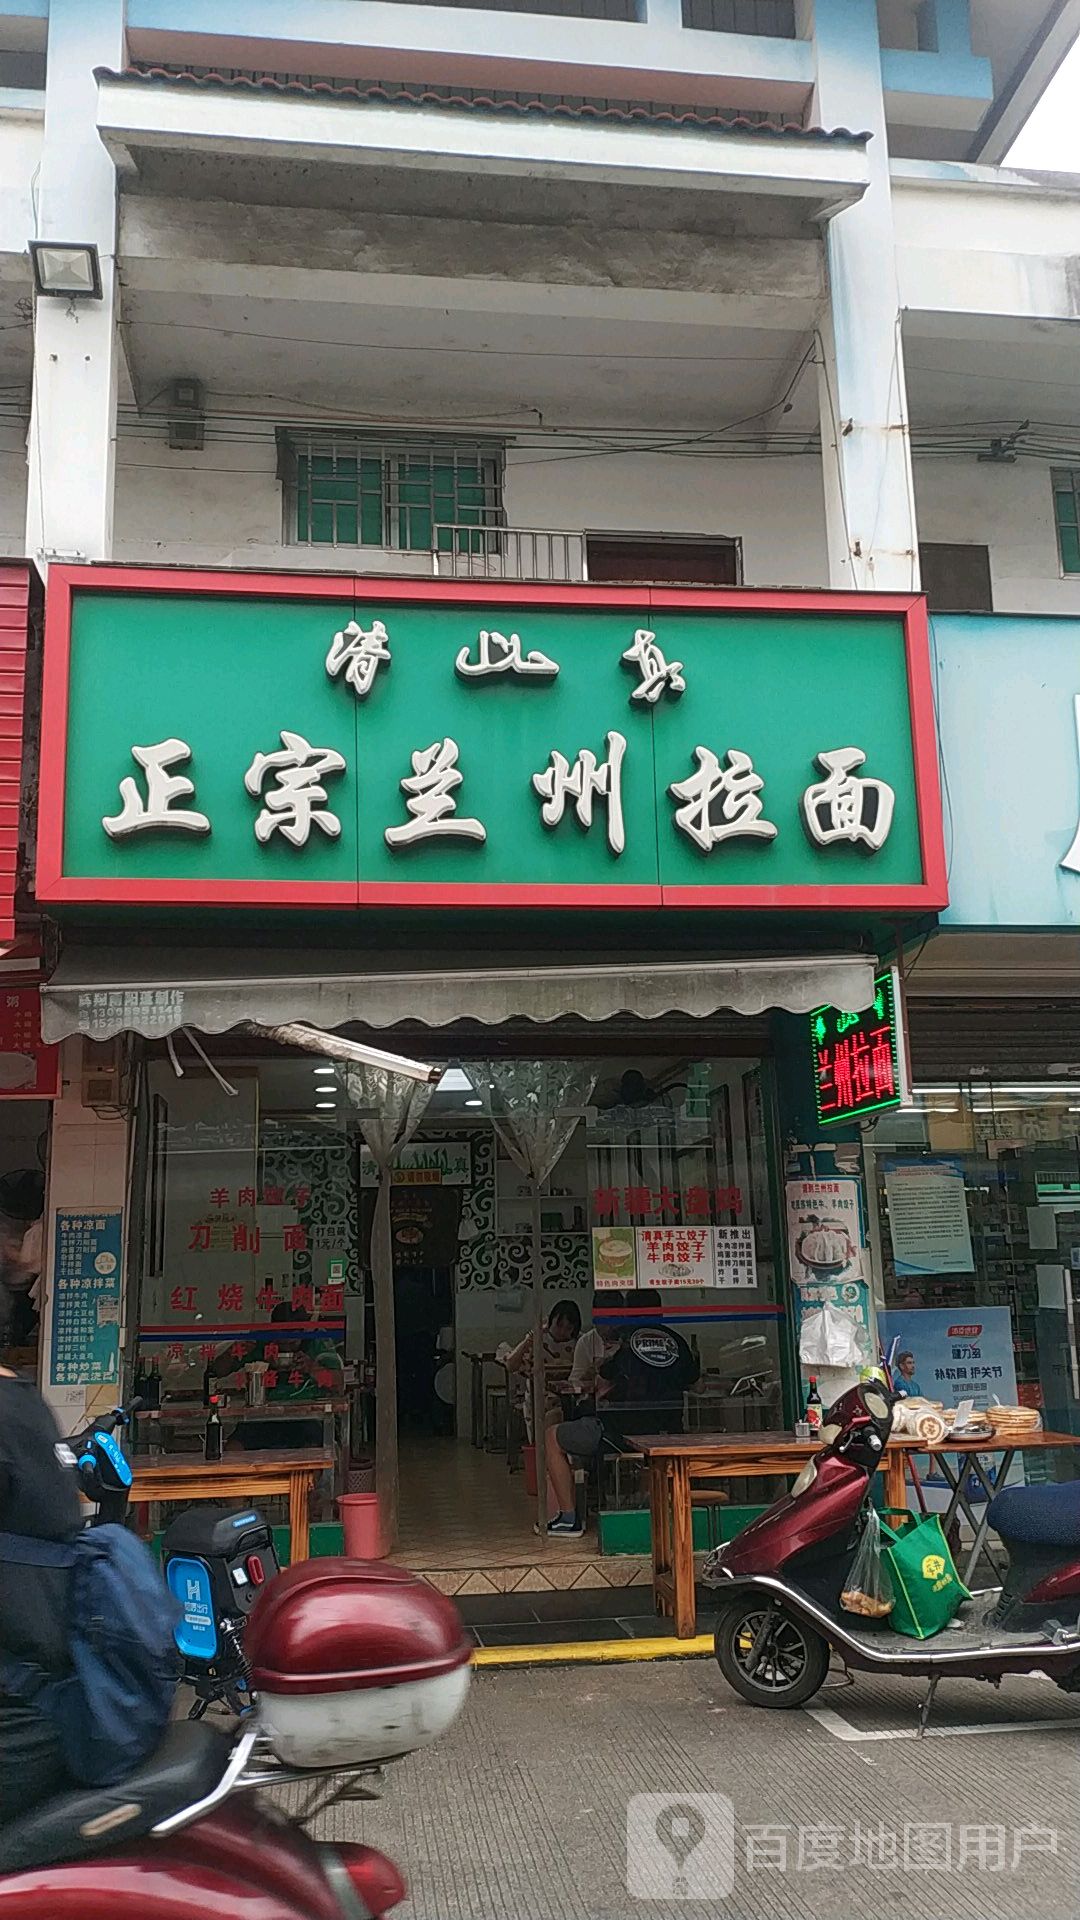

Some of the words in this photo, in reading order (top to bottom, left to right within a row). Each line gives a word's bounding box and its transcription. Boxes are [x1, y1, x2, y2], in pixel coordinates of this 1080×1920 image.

[102, 730, 896, 857] 正宗兰州拉面
[817, 1026, 895, 1110] 兰州拉面
[593, 1185, 743, 1217] 新疆大盘鸡
[60, 1219, 106, 1231] 各种凉面
[188, 1223, 309, 1254] 刀削面
[641, 1230, 708, 1242] 清真手工饺子
[718, 1229, 751, 1240] 新推出
[646, 1241, 705, 1252] 羊肉饺子
[646, 1252, 706, 1263] 牛肉饺子
[58, 1277, 116, 1290] 各种凉拌菜
[169, 1283, 345, 1313] 红烧牛肉面
[56, 1361, 103, 1372] 各种炒菜
